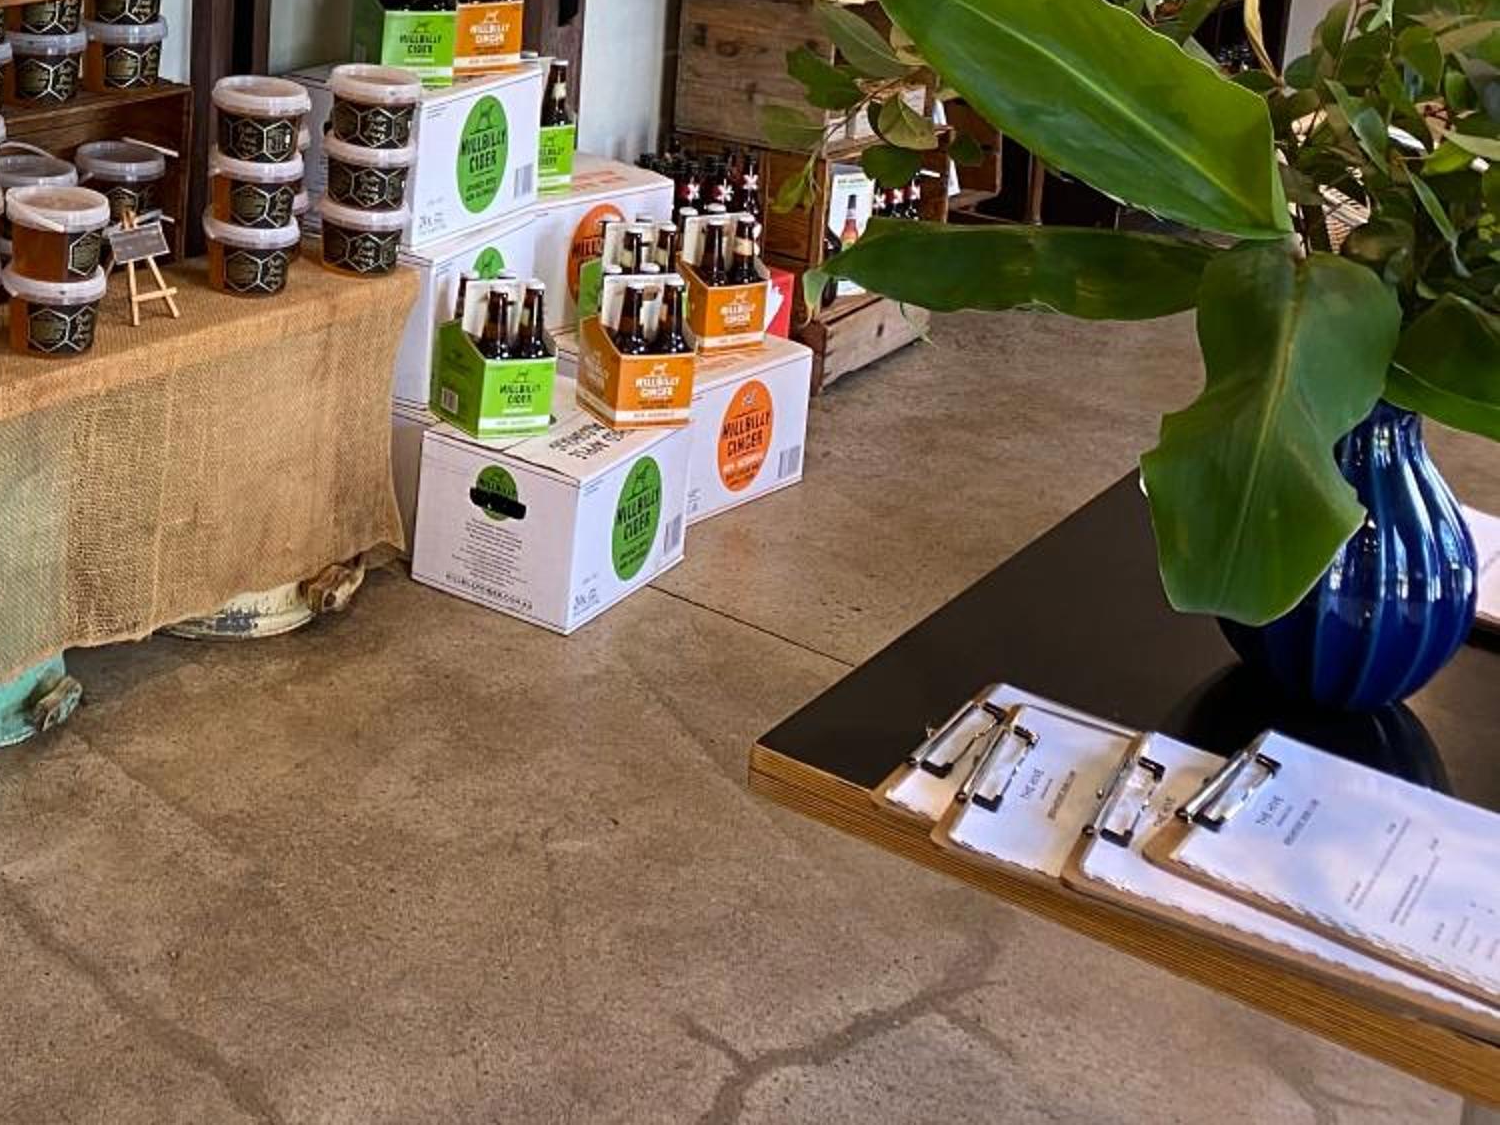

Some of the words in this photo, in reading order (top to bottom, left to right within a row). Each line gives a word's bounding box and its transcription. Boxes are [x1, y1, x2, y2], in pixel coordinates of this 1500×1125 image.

[461, 129, 506, 155] HILLBILLY
[469, 149, 497, 173] CIDER
[723, 410, 771, 439] HILLBILLY
[616, 488, 661, 524] HILLBILLY
[623, 511, 650, 541] CIDER
